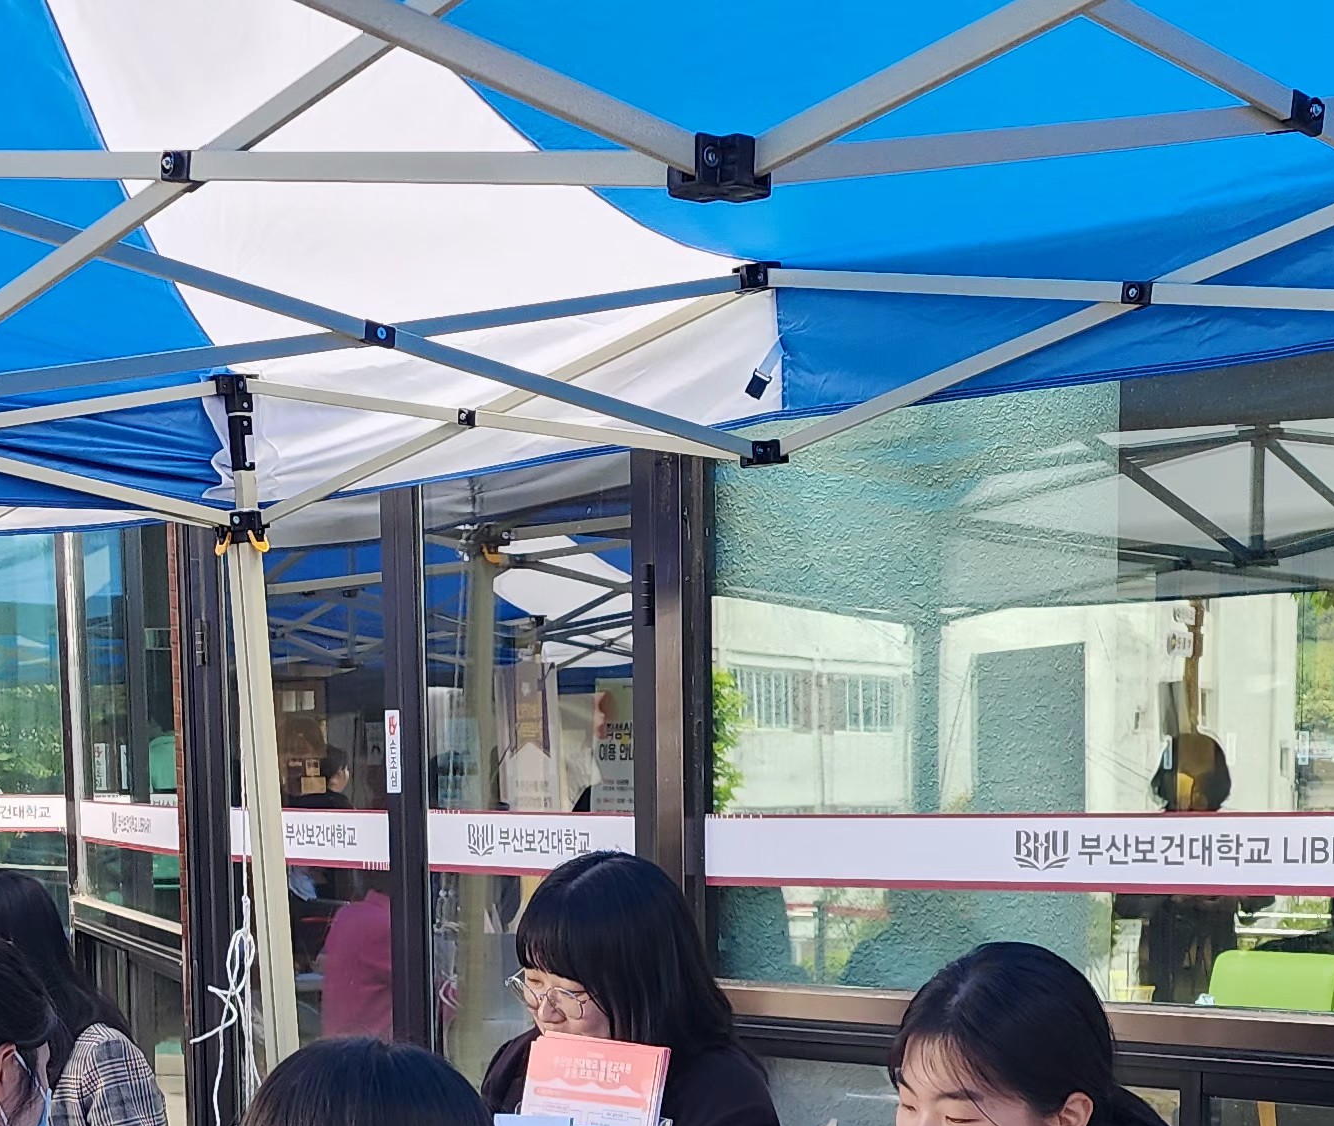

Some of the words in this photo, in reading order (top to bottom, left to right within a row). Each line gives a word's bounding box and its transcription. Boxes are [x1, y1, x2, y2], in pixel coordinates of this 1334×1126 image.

[390, 740, 398, 787] 손조심
[285, 823, 358, 848] 부산보건대학교
[497, 827, 591, 855] 부산보건대학교
[1077, 832, 1273, 867] 부산보건대학교
